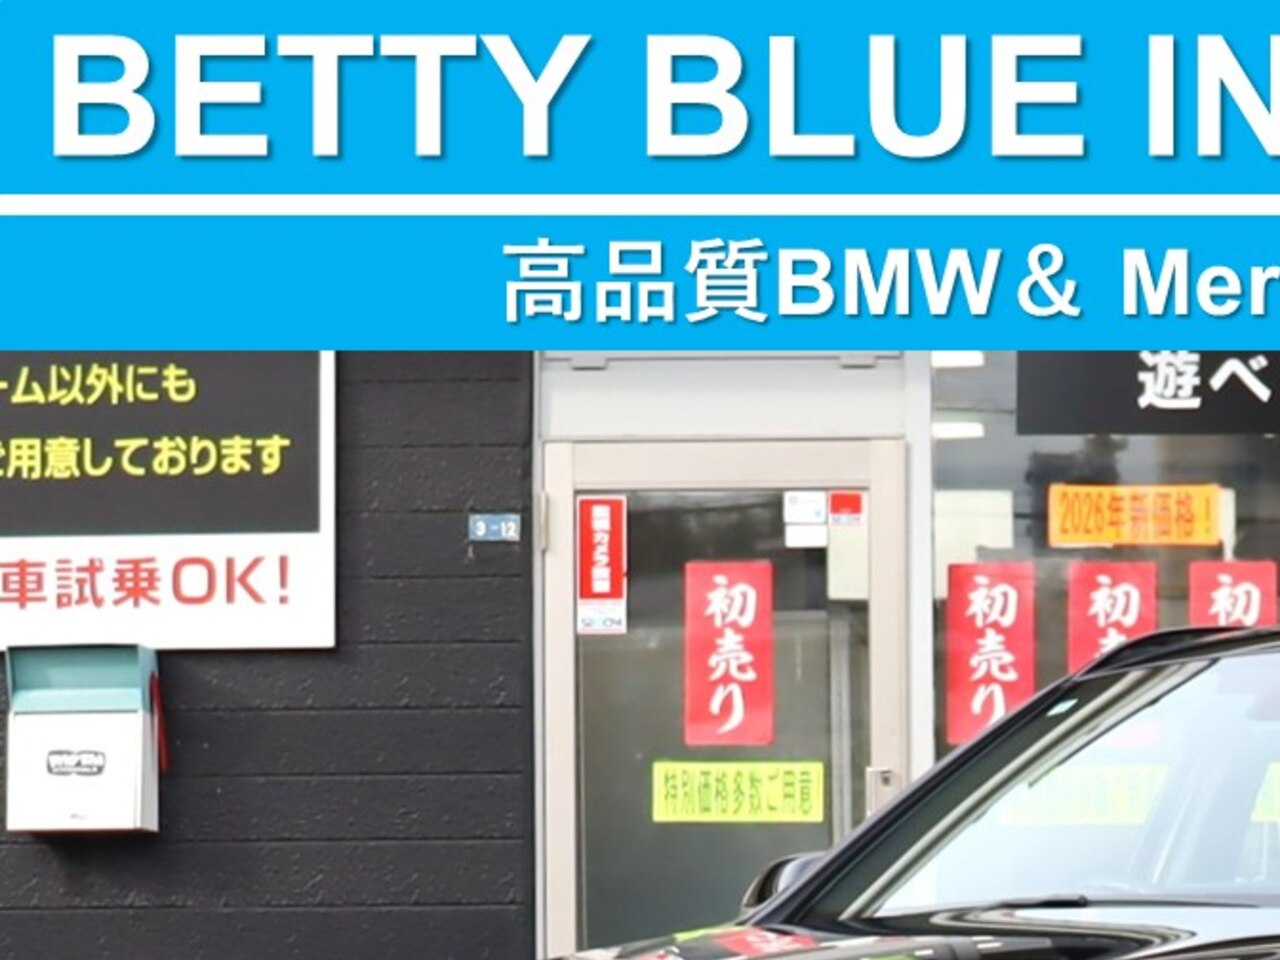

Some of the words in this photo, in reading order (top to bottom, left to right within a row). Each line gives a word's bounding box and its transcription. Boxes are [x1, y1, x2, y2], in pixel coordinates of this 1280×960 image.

[0, 363, 197, 405] ム以外にも
[0, 555, 291, 610] 車試乗OK!
[704, 574, 758, 733] 初売り
[965, 574, 1018, 726] 初売り
